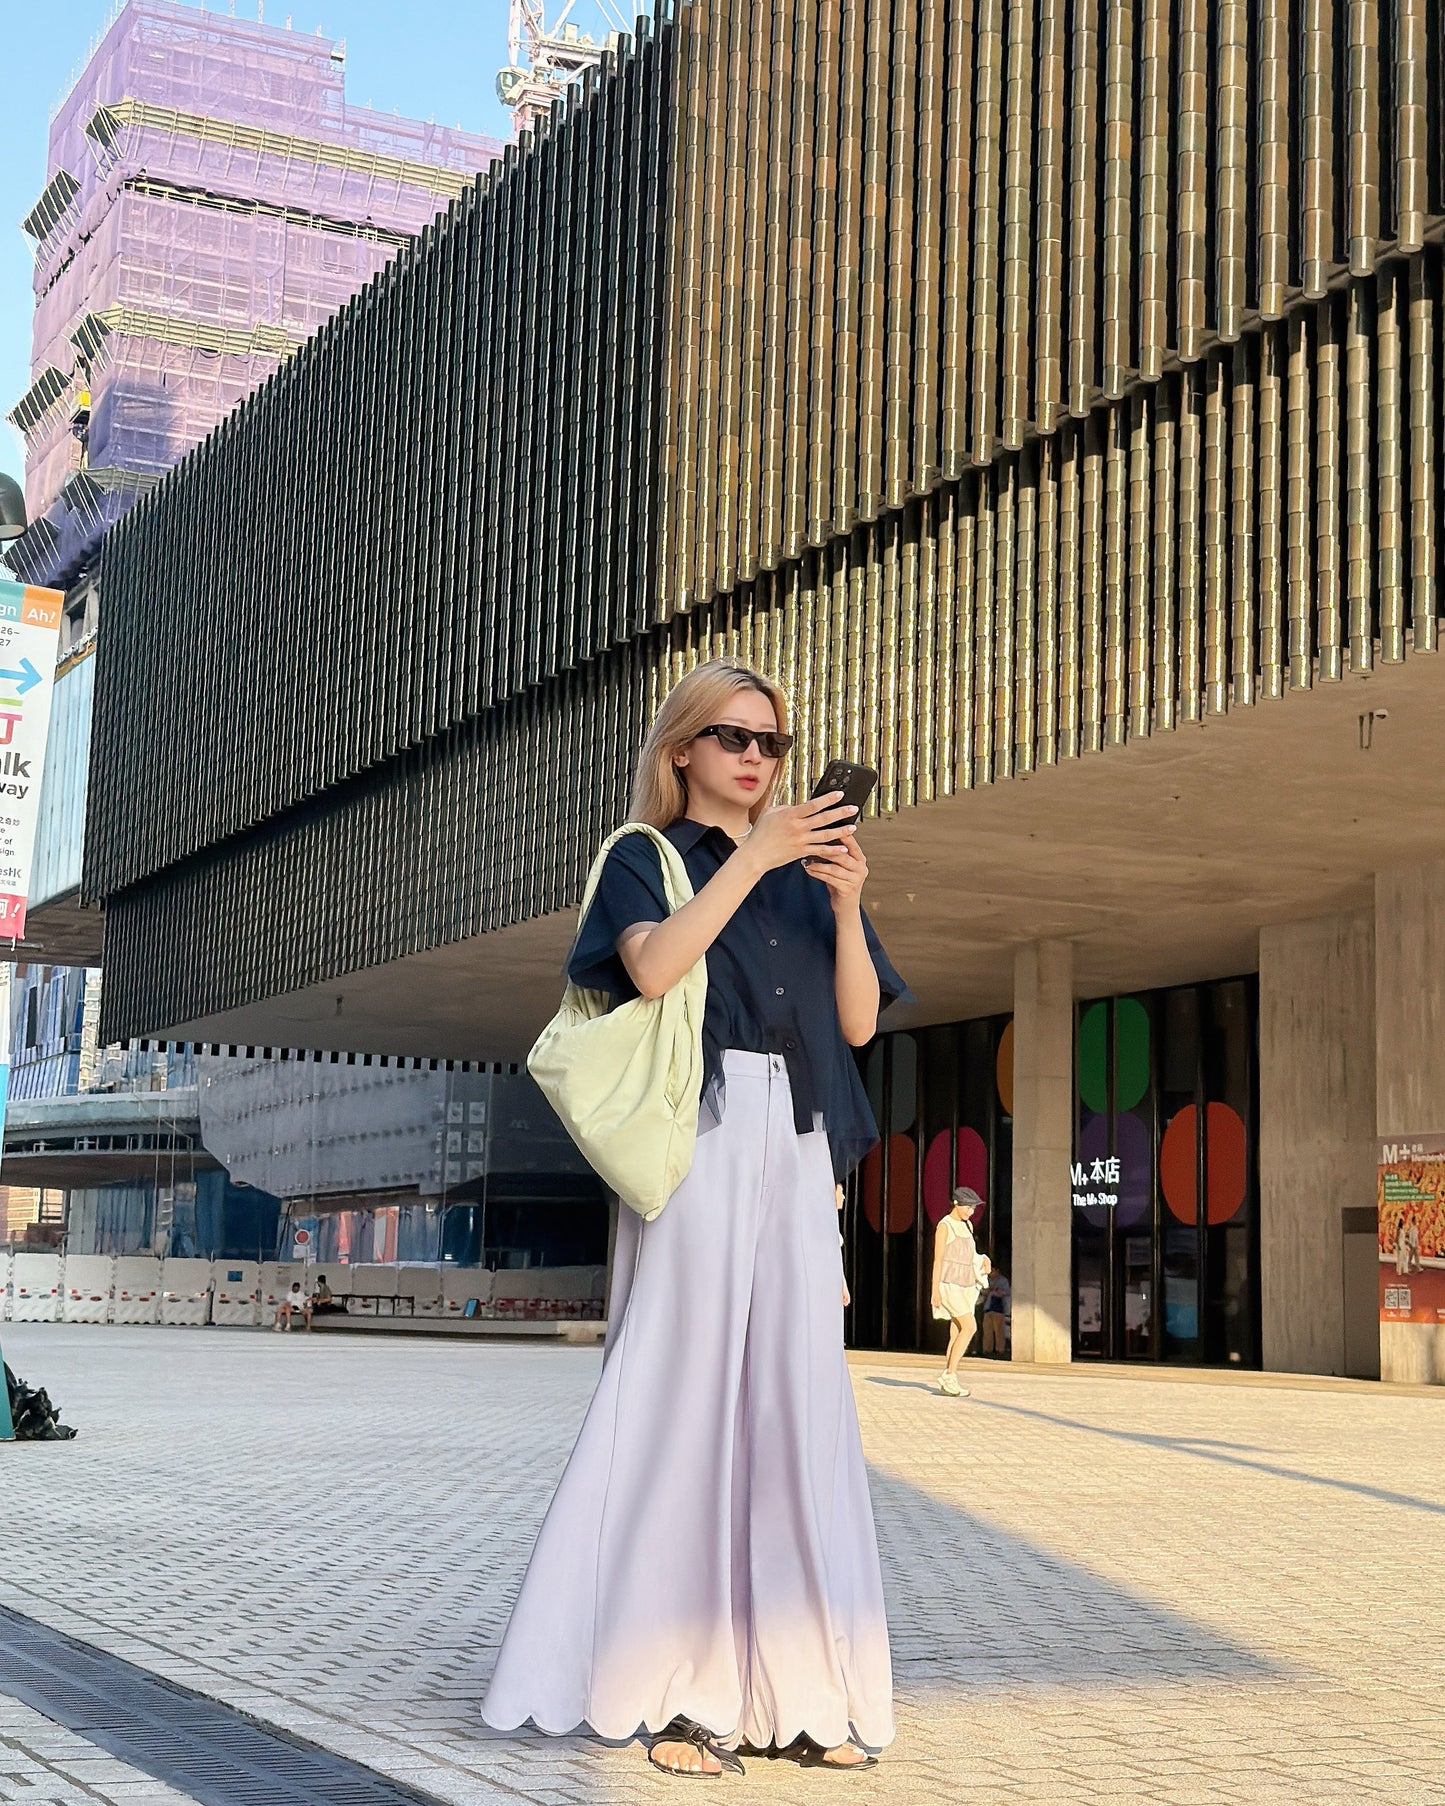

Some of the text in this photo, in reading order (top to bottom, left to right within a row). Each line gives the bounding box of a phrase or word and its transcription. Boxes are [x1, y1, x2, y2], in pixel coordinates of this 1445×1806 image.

[27, 608, 56, 623] Ah!
[0, 751, 31, 778] lk
[1382, 1144, 1410, 1164] M+
[1070, 1156, 1120, 1186] M+ 本店
[1072, 1194, 1087, 1206] The
[1098, 1192, 1118, 1206] Shop
